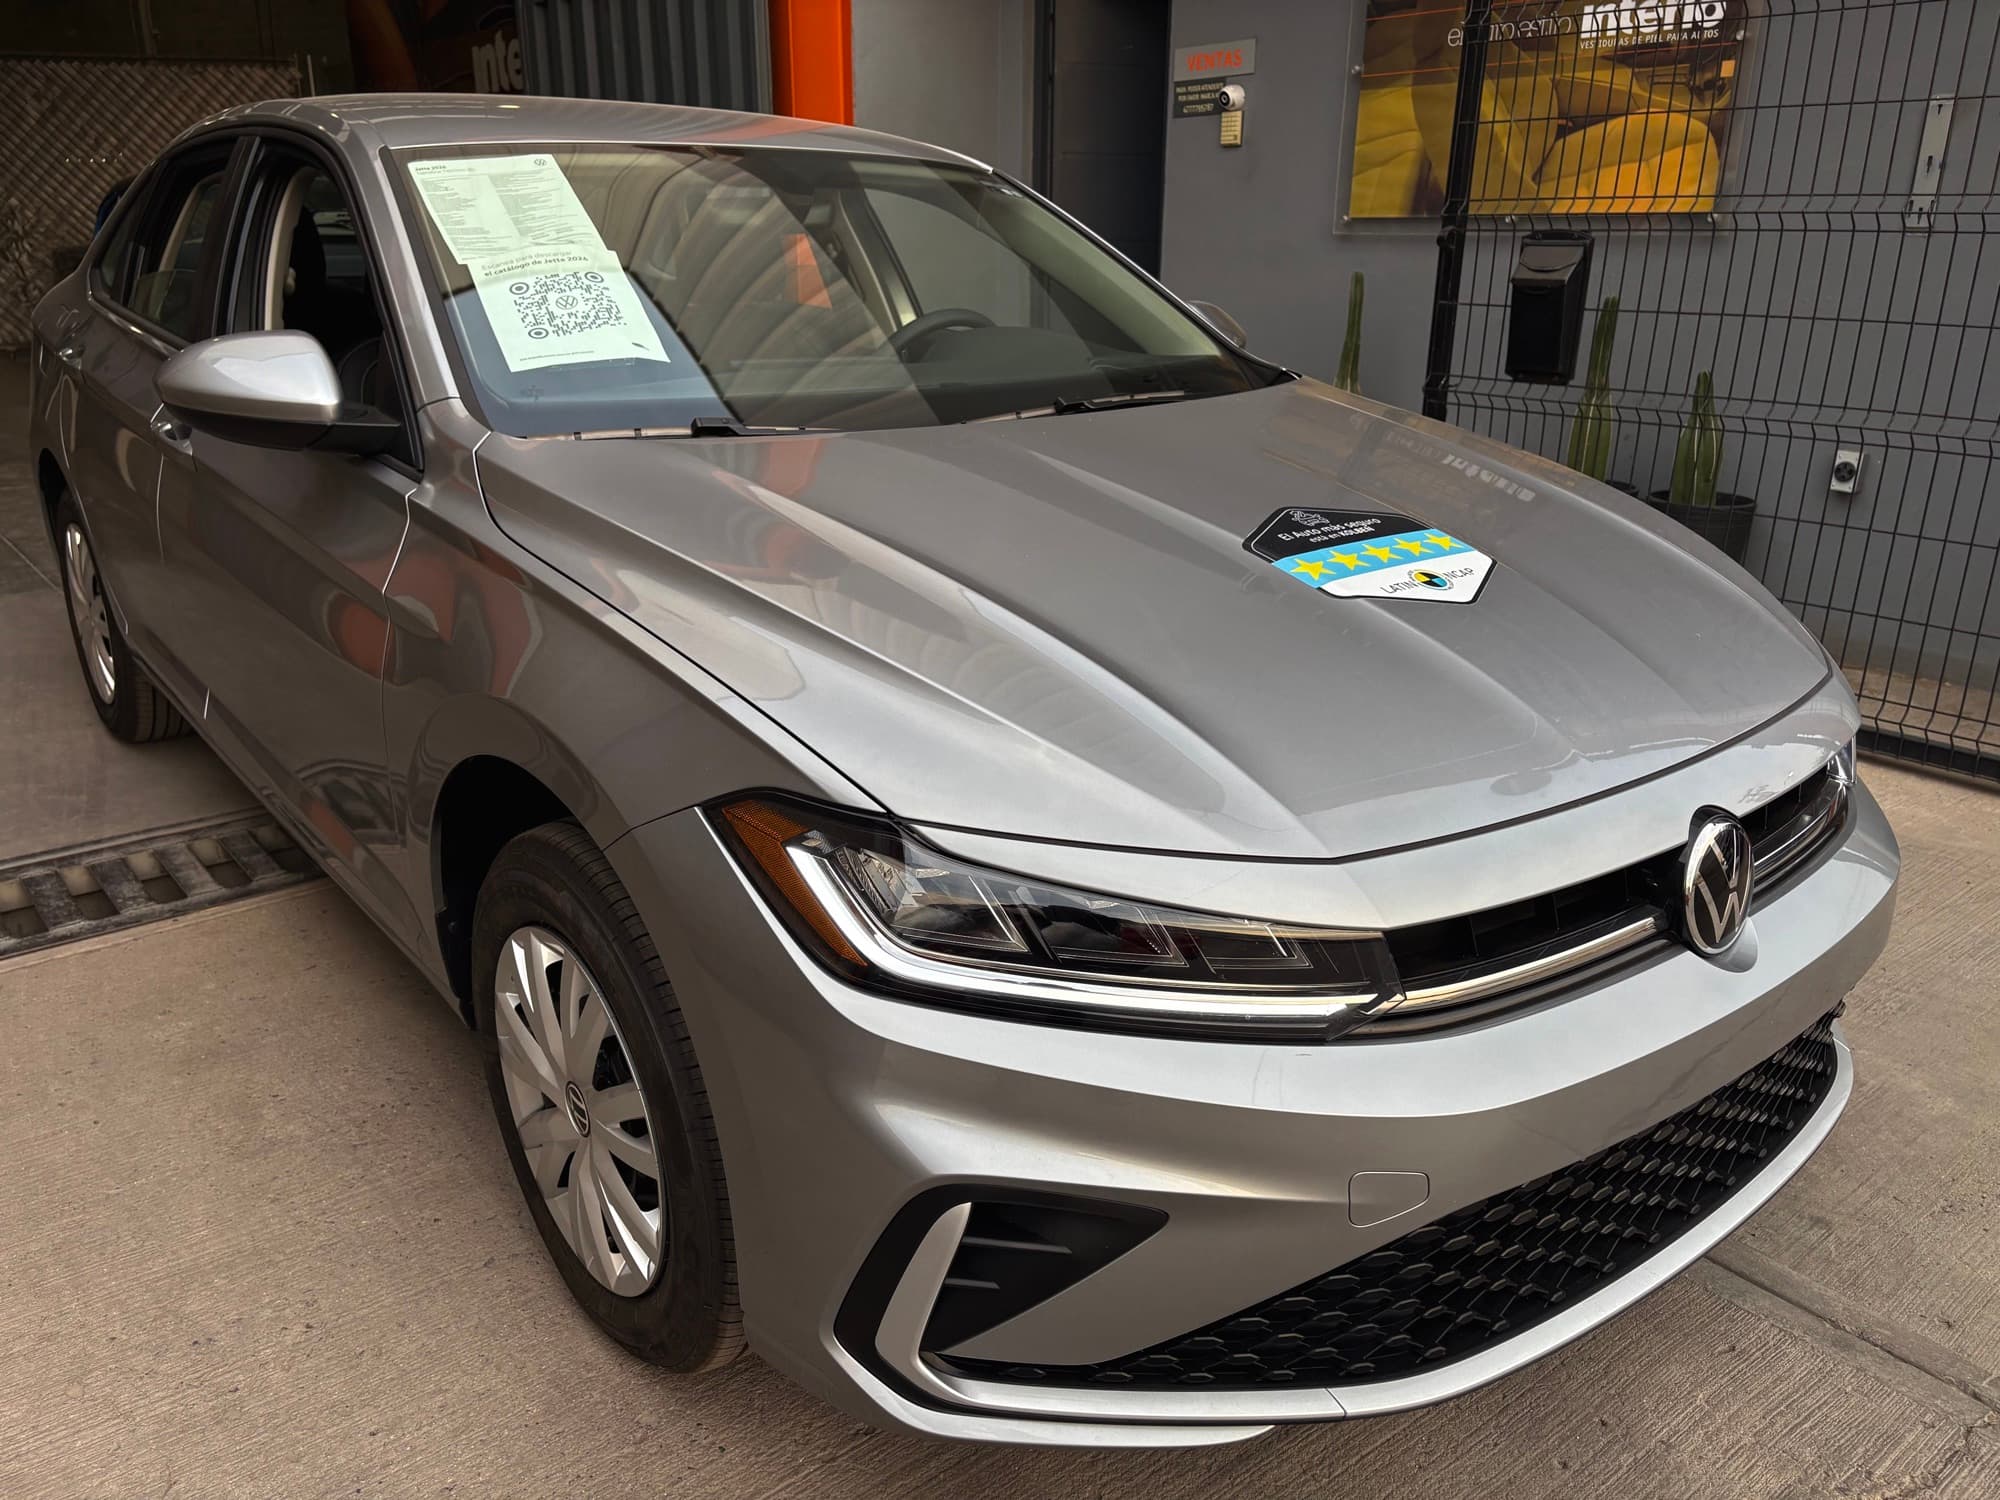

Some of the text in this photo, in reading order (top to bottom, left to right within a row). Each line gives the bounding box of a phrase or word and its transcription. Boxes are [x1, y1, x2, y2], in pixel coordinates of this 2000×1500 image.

[1580, 36, 1630, 49] VESIDUAS
[1187, 49, 1243, 72] VENTAS
[1277, 533, 1295, 541] El
[1292, 528, 1321, 538] Auto
[1379, 567, 1475, 594] LATIN NCAP
